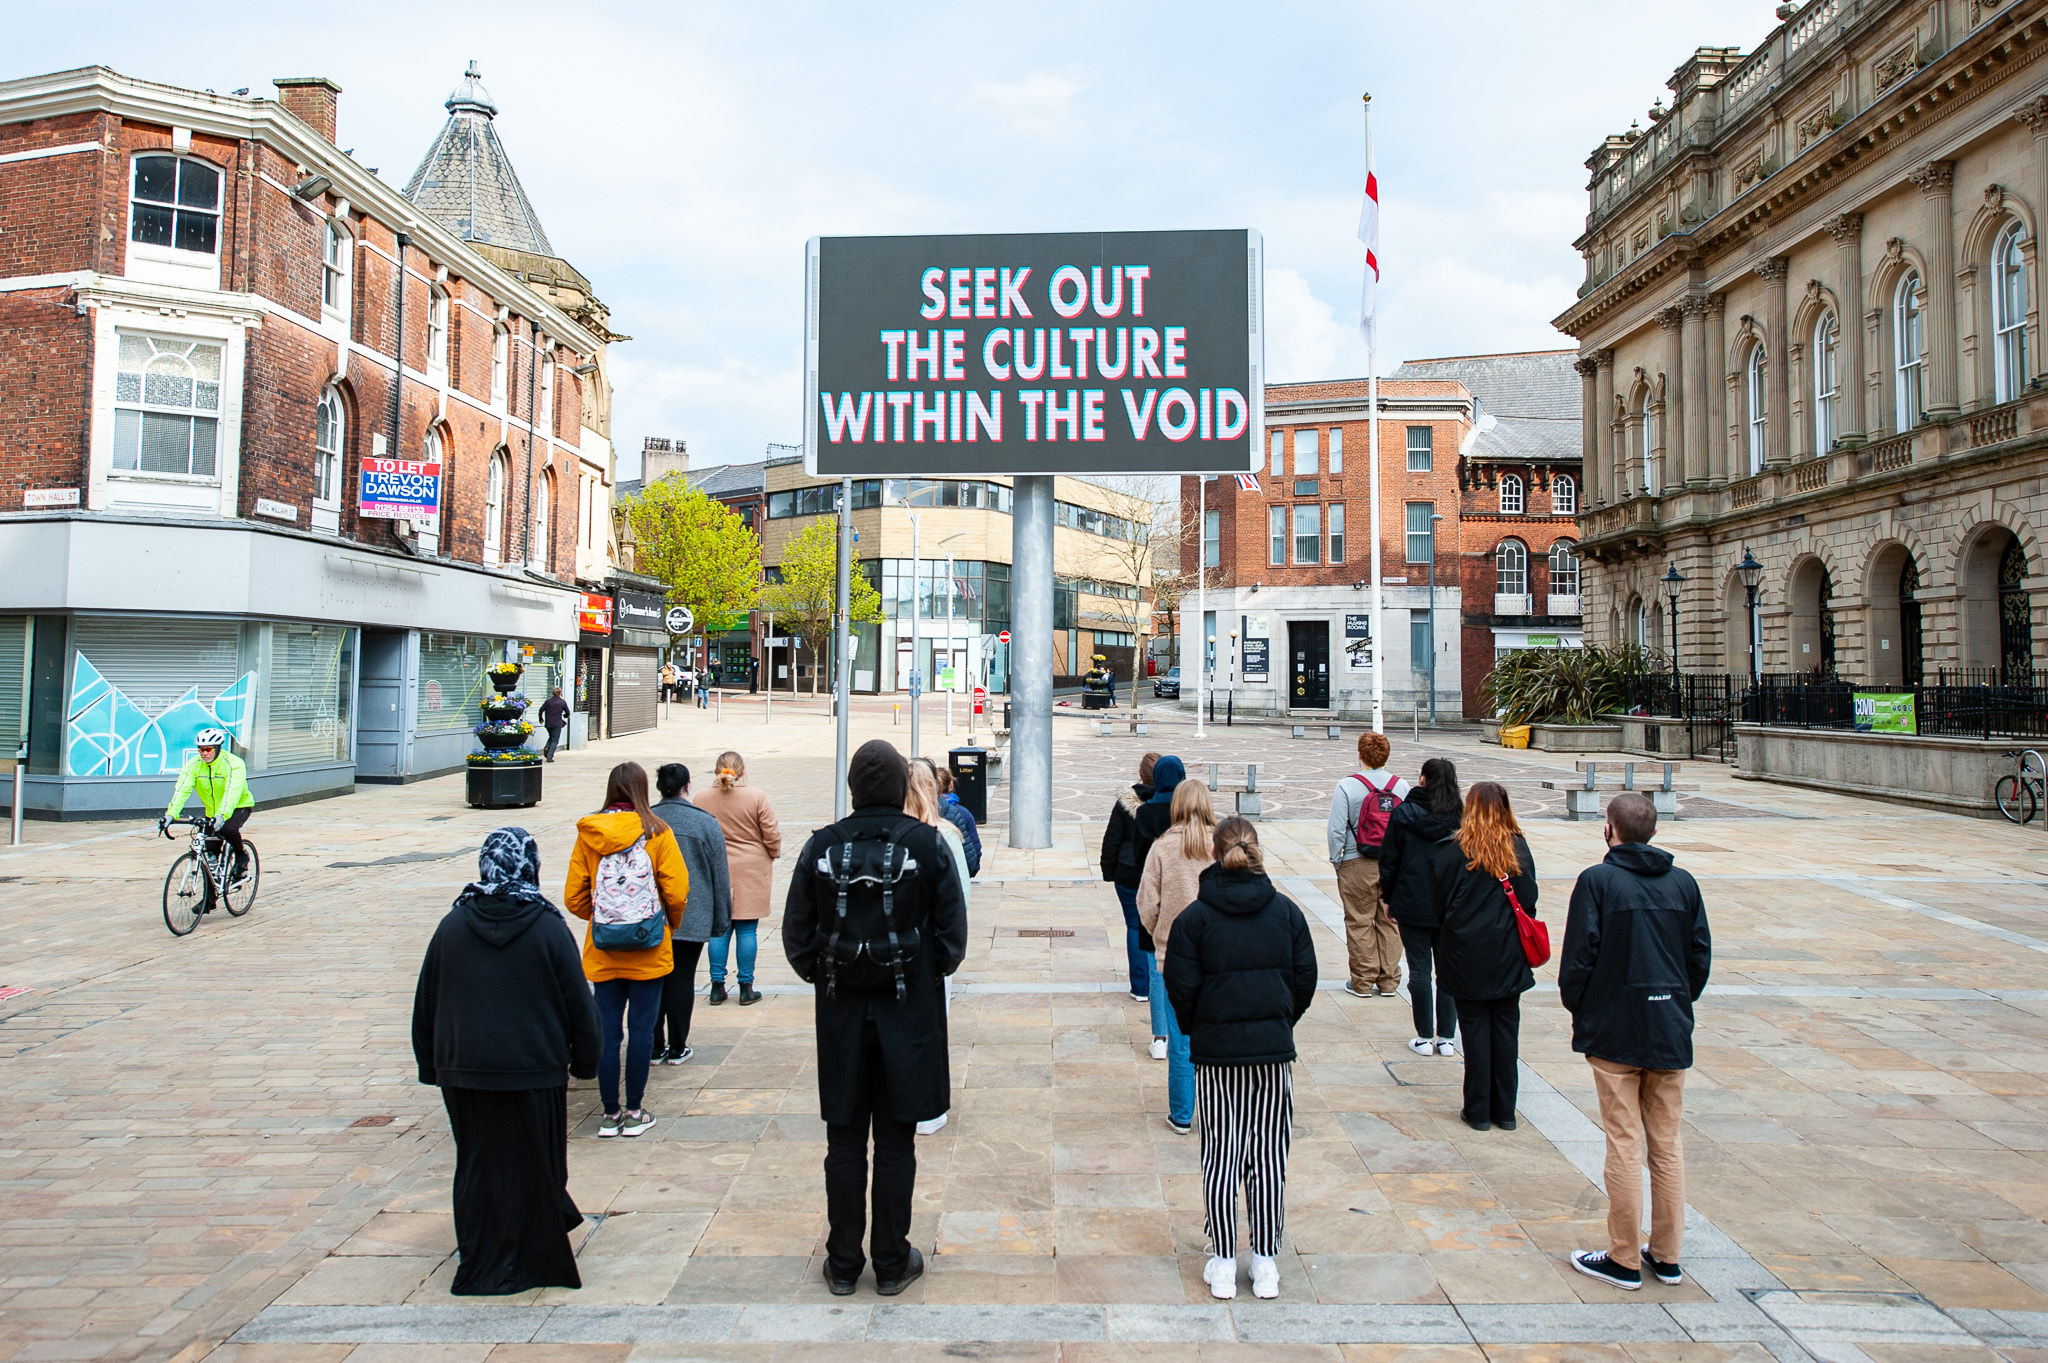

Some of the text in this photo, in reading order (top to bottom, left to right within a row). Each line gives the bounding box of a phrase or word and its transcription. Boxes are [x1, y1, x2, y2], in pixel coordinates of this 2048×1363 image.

[919, 264, 1151, 320] SEEK OUT
[880, 326, 1187, 381] THE CULTURE
[820, 386, 1248, 443] WITHIN THE VOID
[374, 459, 427, 475] TO LET
[366, 471, 435, 487] TREVOR
[27, 491, 77, 502] TOWN HALL ST
[365, 482, 435, 498] DAWSON
[367, 510, 430, 520] PRICE REDUCED
[374, 503, 397, 512] 01254
[1529, 636, 1556, 645] inspire
[1855, 698, 1876, 716] COVID
